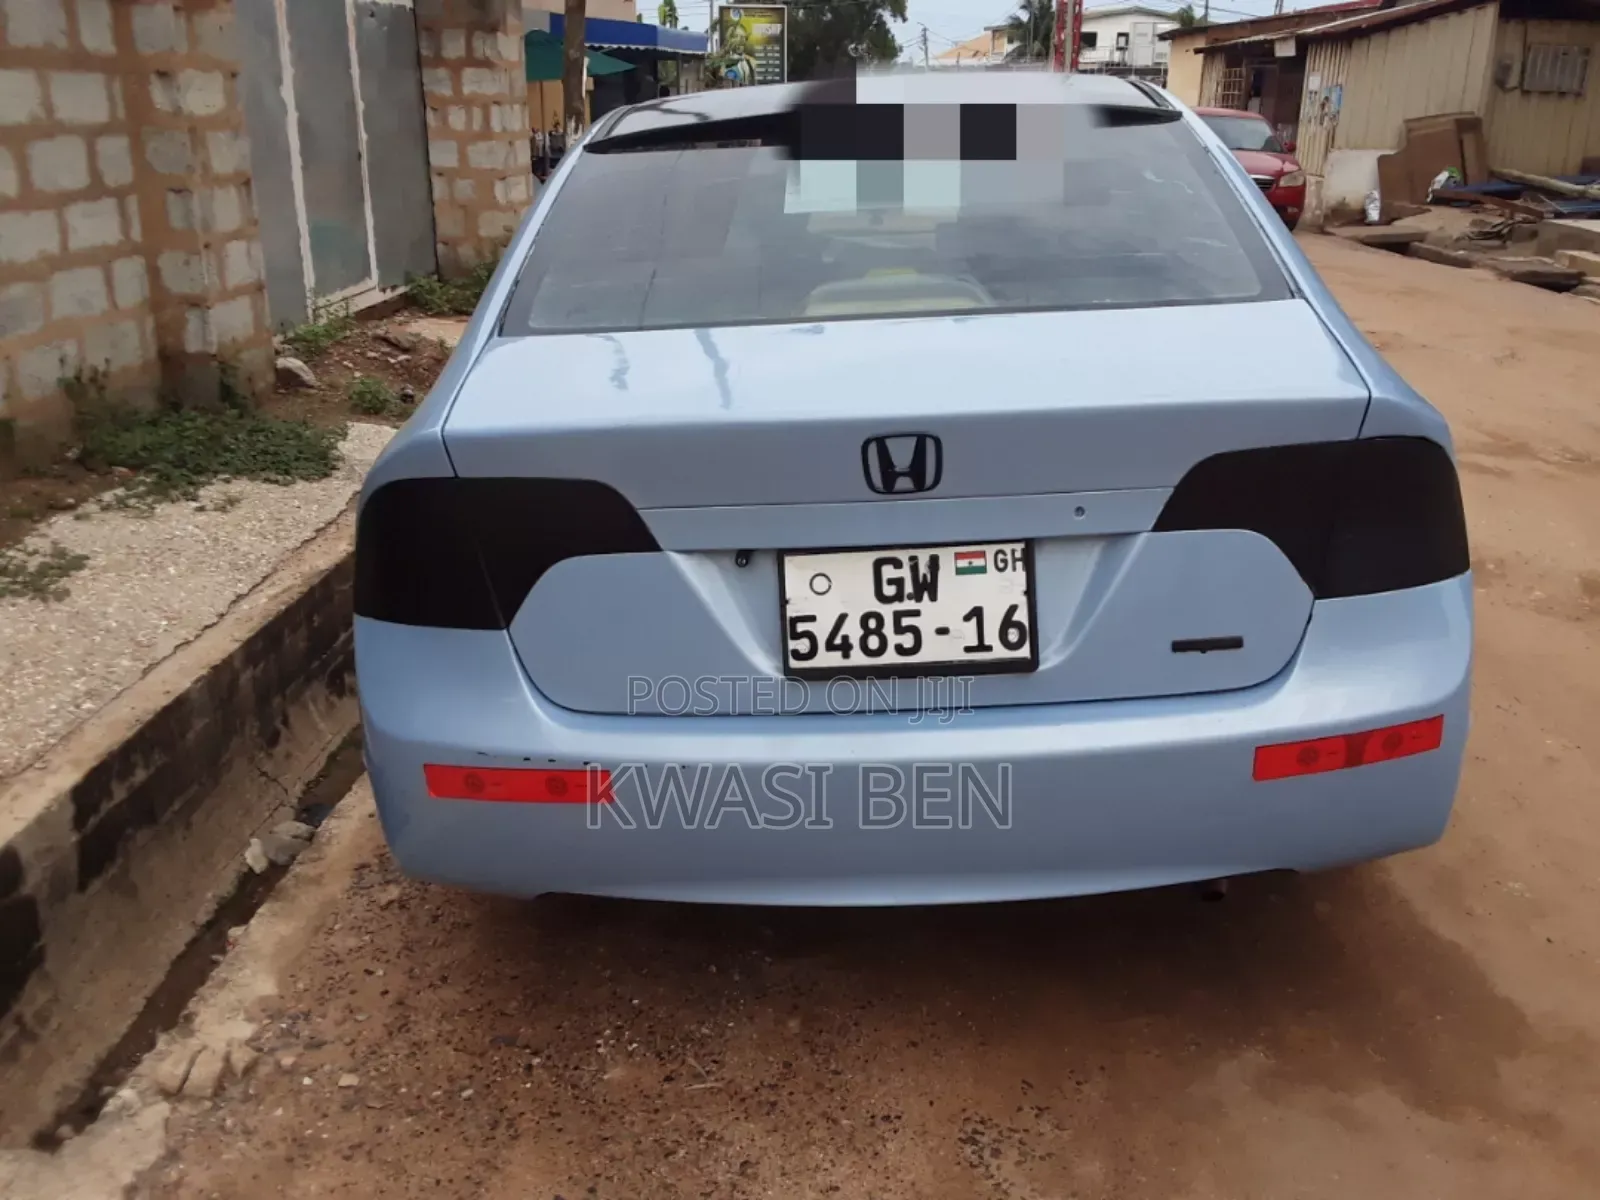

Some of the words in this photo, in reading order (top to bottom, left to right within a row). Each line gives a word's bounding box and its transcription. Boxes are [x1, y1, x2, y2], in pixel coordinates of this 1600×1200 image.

[872, 554, 940, 604] GW
[993, 548, 1026, 573] GH
[789, 604, 1028, 661] 5485-16
